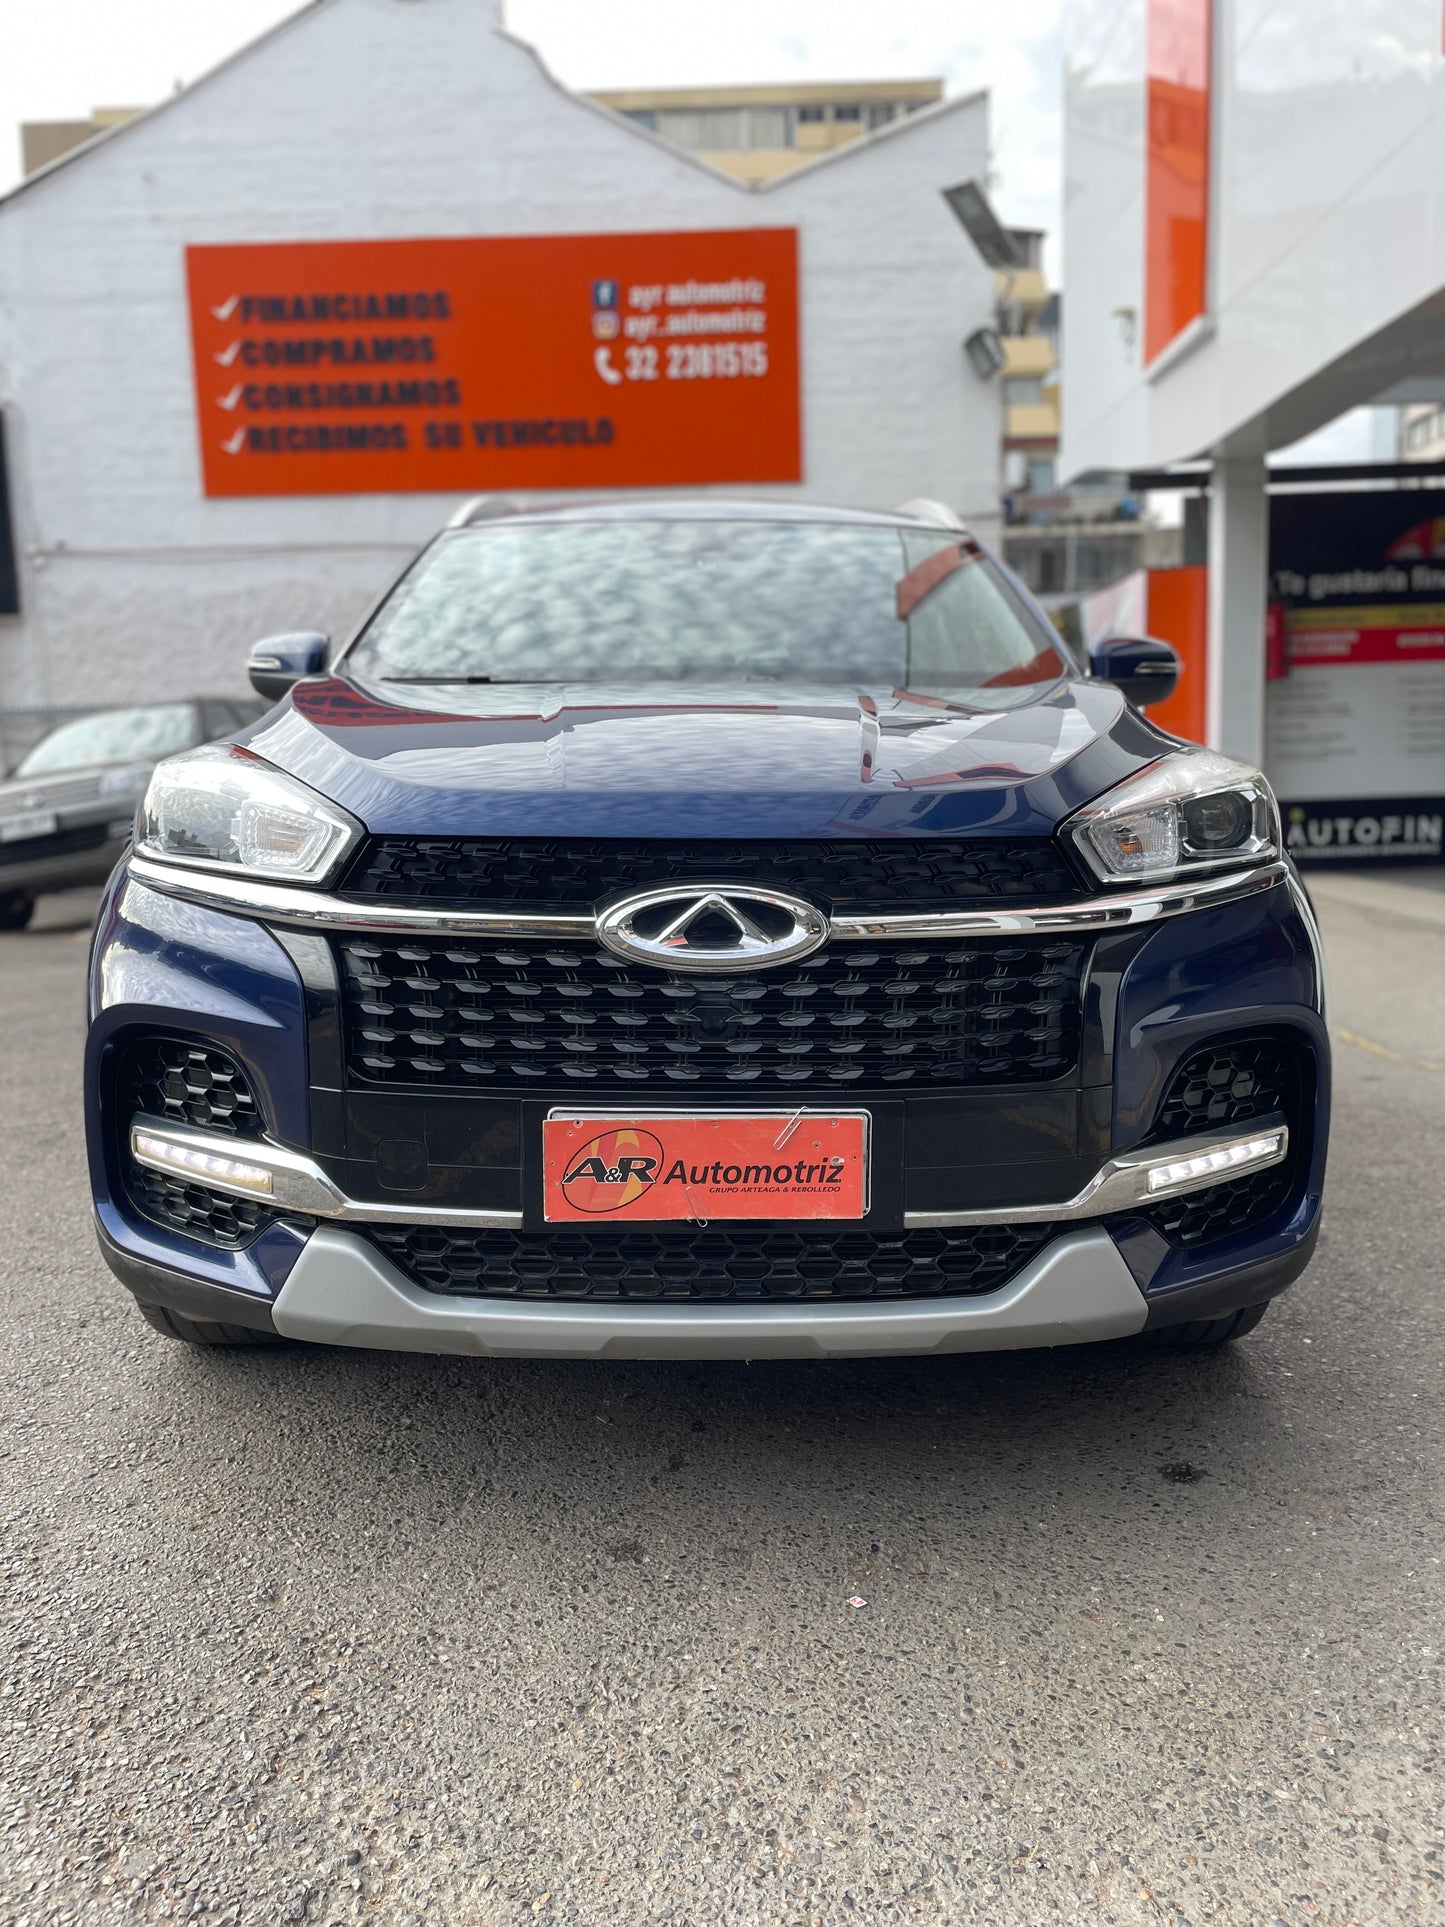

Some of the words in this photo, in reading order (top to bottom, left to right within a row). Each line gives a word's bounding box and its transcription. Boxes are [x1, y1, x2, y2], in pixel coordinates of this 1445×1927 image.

[240, 291, 451, 324] FINANCIAMOS
[629, 284, 663, 312] ayr
[665, 277, 767, 306] automotriz
[241, 333, 435, 368] COMPRAMOS
[624, 344, 659, 381] 32
[665, 340, 769, 380] 2381515
[244, 377, 463, 412] CONSIGNAMOS
[247, 422, 408, 452] RECIBIMOS
[424, 419, 464, 449] SU
[472, 415, 615, 447] VEHICULO
[1308, 565, 1408, 600] gustaría
[1286, 806, 1444, 847] AUTOFIN
[562, 1156, 656, 1185] A&R
[662, 1157, 843, 1185] Automotriz
[709, 1186, 739, 1194] GRUPO
